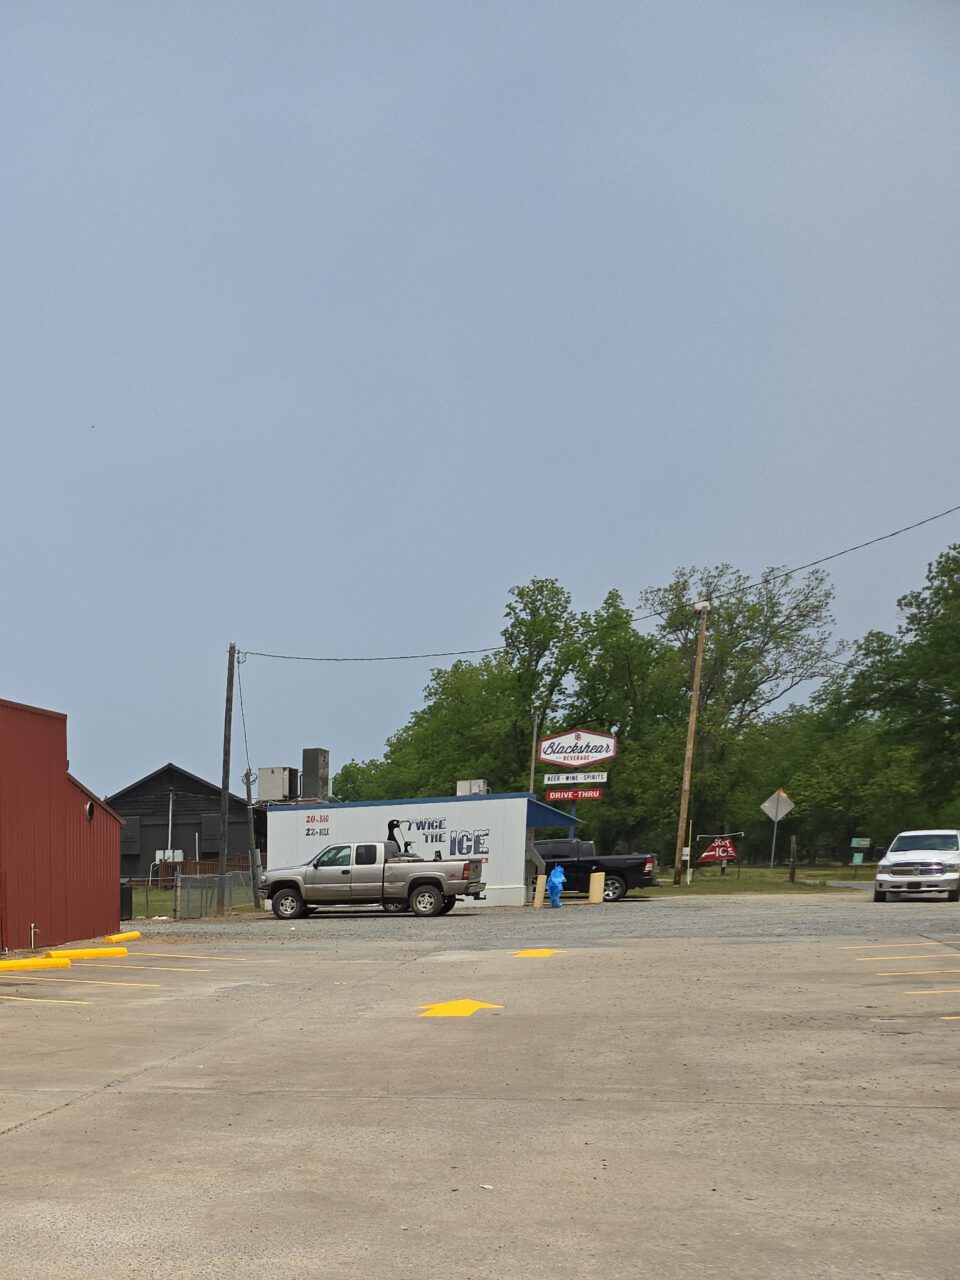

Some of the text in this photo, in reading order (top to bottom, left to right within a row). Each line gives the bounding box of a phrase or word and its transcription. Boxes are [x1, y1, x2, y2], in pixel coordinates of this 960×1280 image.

[543, 742, 611, 755] Blackshear
[550, 791, 599, 799] DRIVE-THRU
[305, 815, 316, 824] 20
[407, 816, 447, 831] TWICE
[423, 832, 446, 843] THE
[449, 828, 490, 856] ICE
[715, 847, 735, 857] ICE
